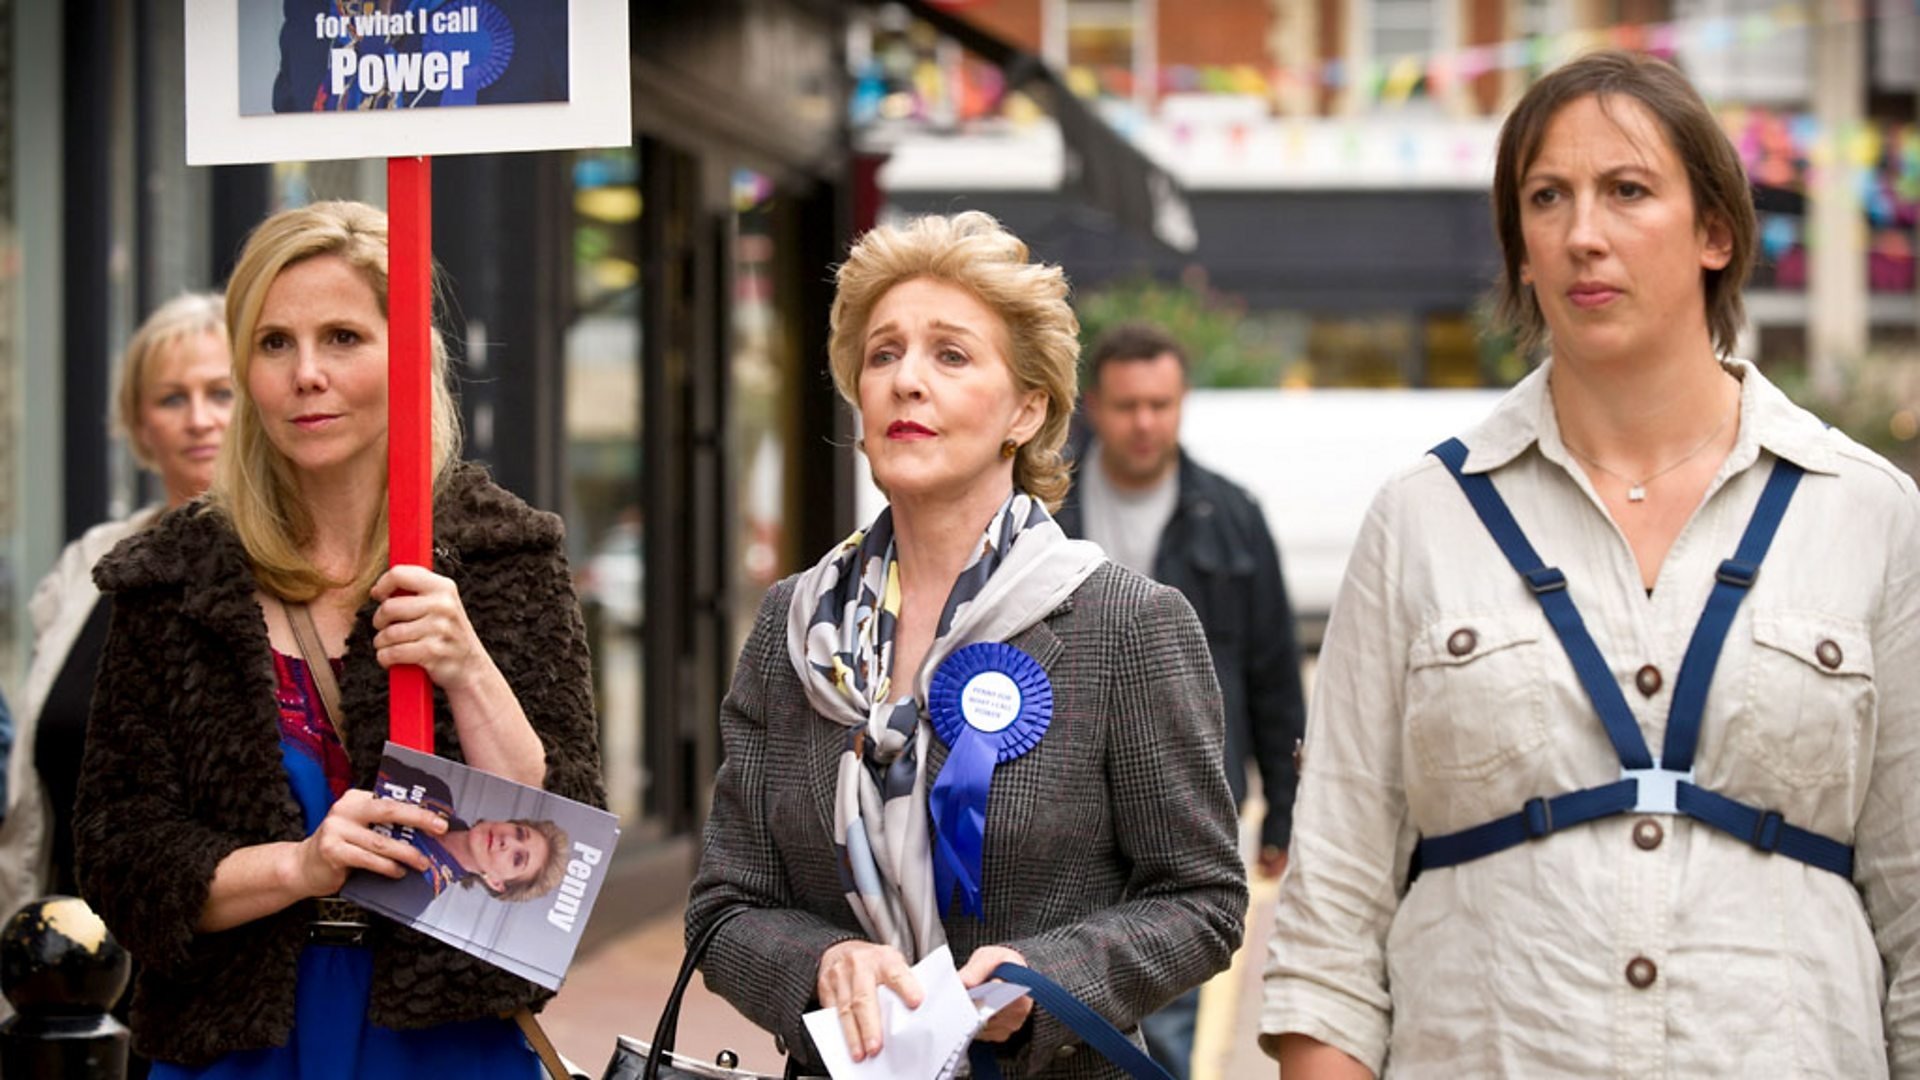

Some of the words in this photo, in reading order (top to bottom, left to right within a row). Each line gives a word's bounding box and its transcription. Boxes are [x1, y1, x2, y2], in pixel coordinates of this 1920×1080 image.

[315, 13, 350, 39] for
[355, 10, 414, 36] what
[419, 8, 428, 34] I
[432, 6, 478, 34] call
[330, 48, 470, 95] Power
[547, 841, 603, 933] Penny
